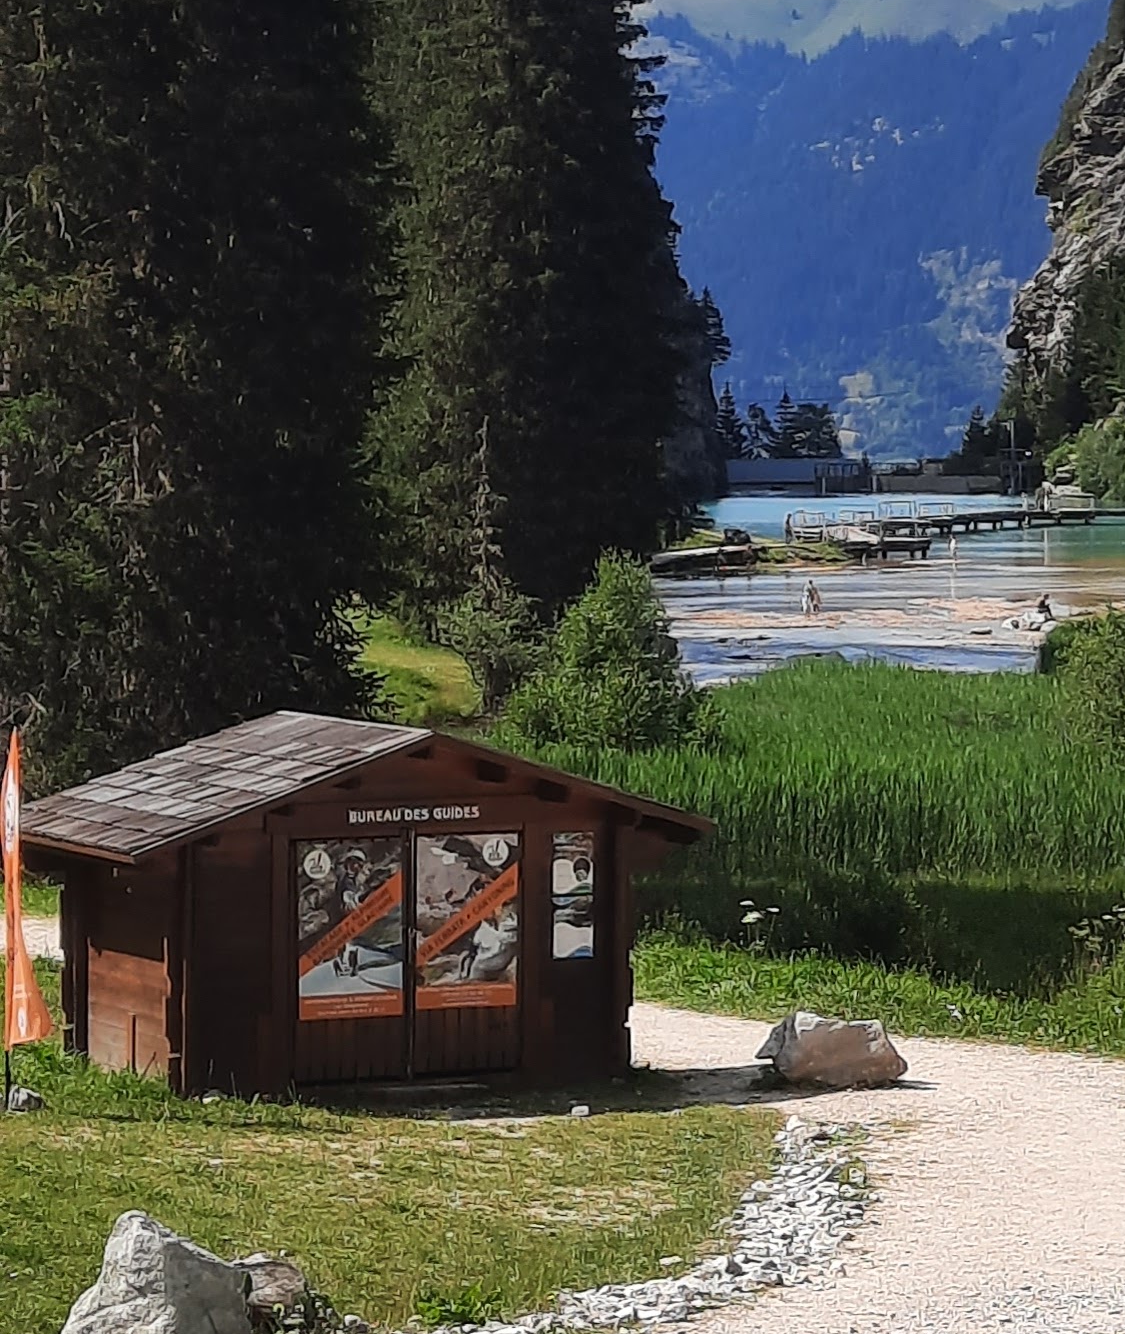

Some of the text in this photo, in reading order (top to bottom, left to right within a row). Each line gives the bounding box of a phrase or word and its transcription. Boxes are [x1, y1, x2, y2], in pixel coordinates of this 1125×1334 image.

[348, 805, 480, 823] BUREAU DES GUIDES
